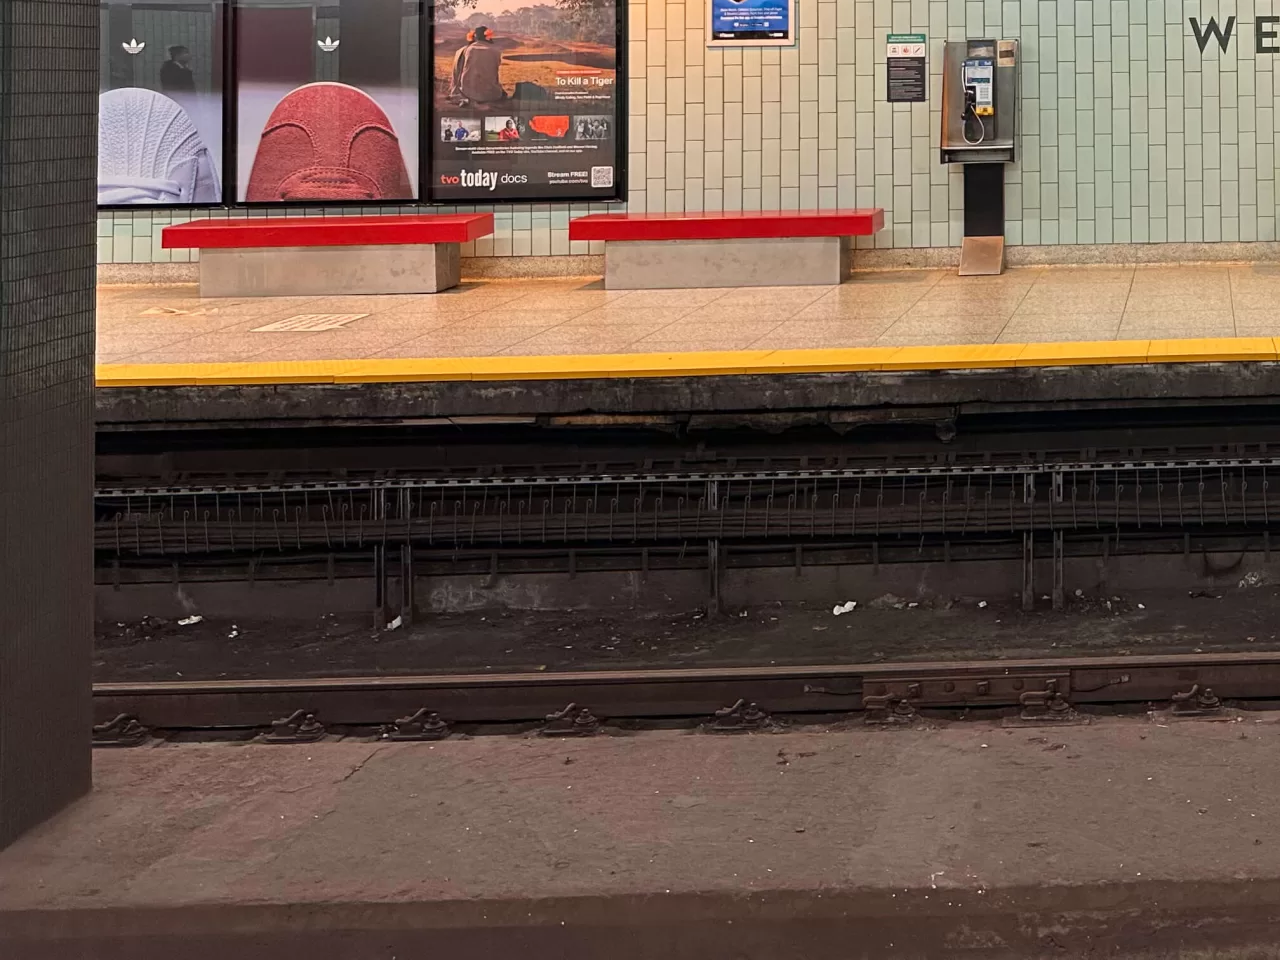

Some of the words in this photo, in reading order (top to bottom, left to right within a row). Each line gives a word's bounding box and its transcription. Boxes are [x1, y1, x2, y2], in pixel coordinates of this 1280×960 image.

[556, 76, 566, 86] To
[567, 76, 582, 86] Kill
[590, 76, 613, 87] Tiger
[441, 174, 460, 184] tvo
[460, 169, 498, 191] today
[501, 173, 528, 183] docs
